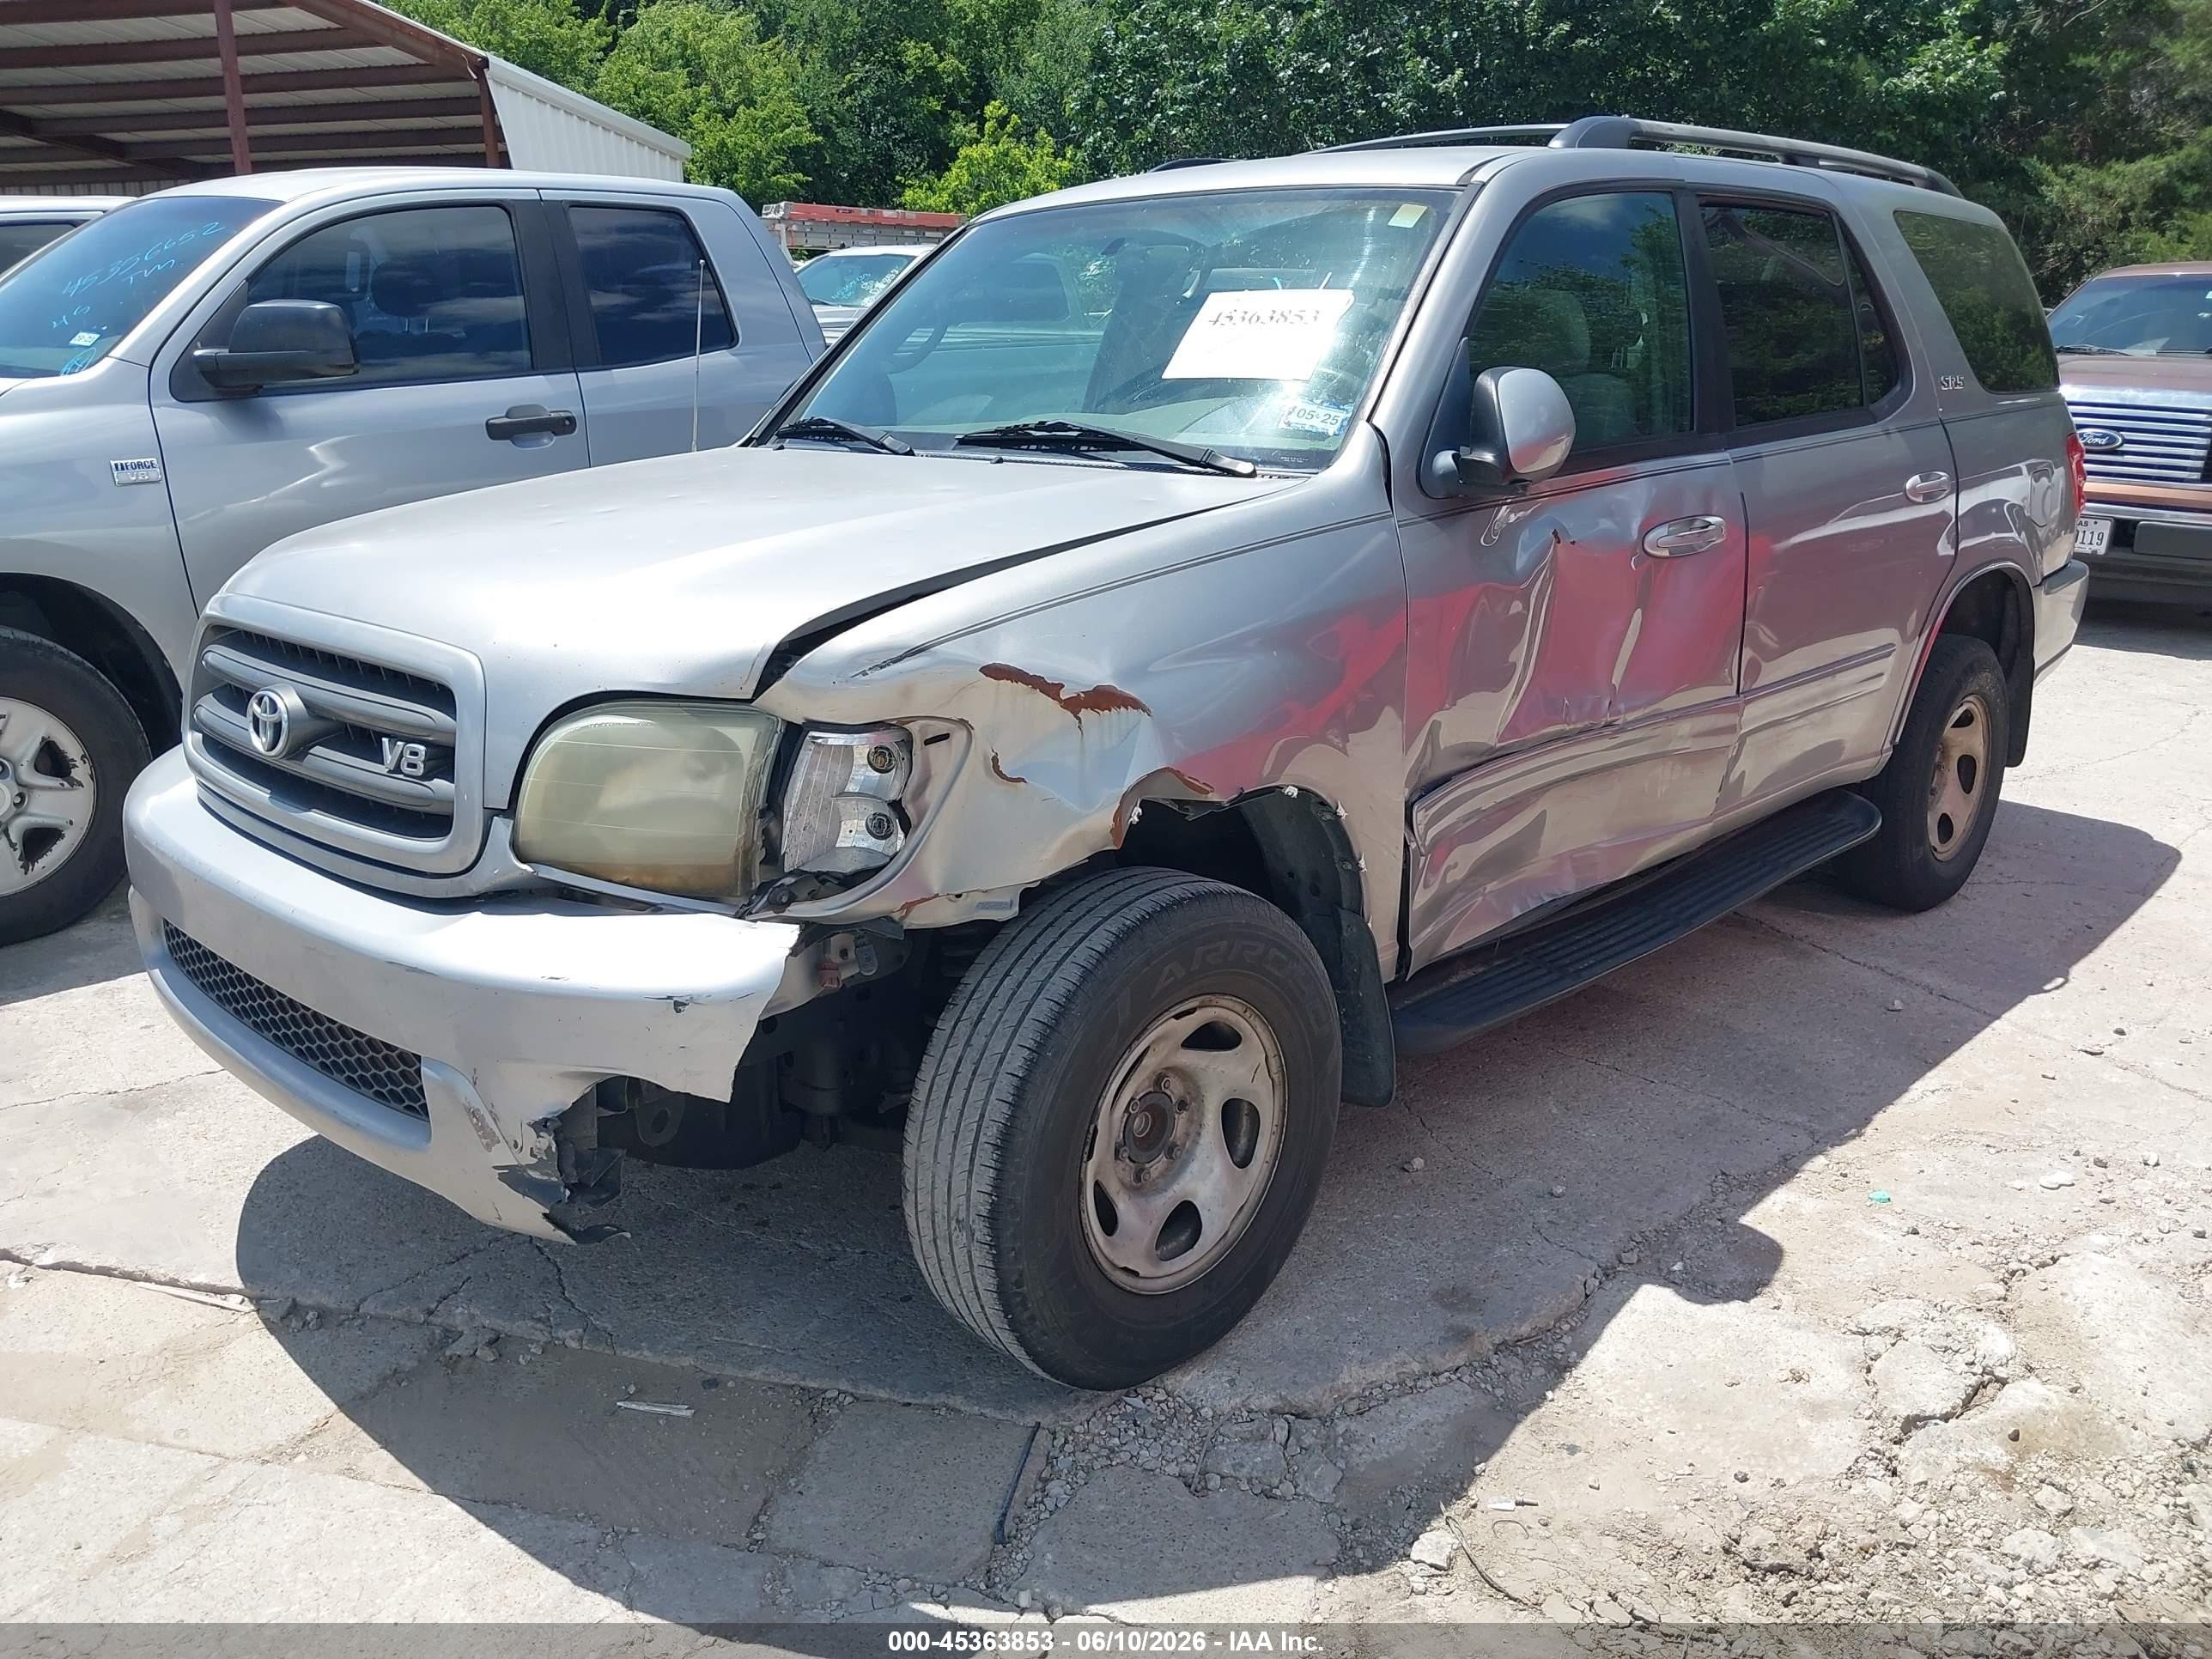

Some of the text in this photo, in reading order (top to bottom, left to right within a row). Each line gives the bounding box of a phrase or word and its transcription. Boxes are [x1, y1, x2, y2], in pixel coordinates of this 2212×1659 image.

[1941, 375, 1965, 390] SR5
[2081, 432, 2110, 445] Ford
[2075, 530, 2105, 546] 119
[381, 737, 428, 777] V8
